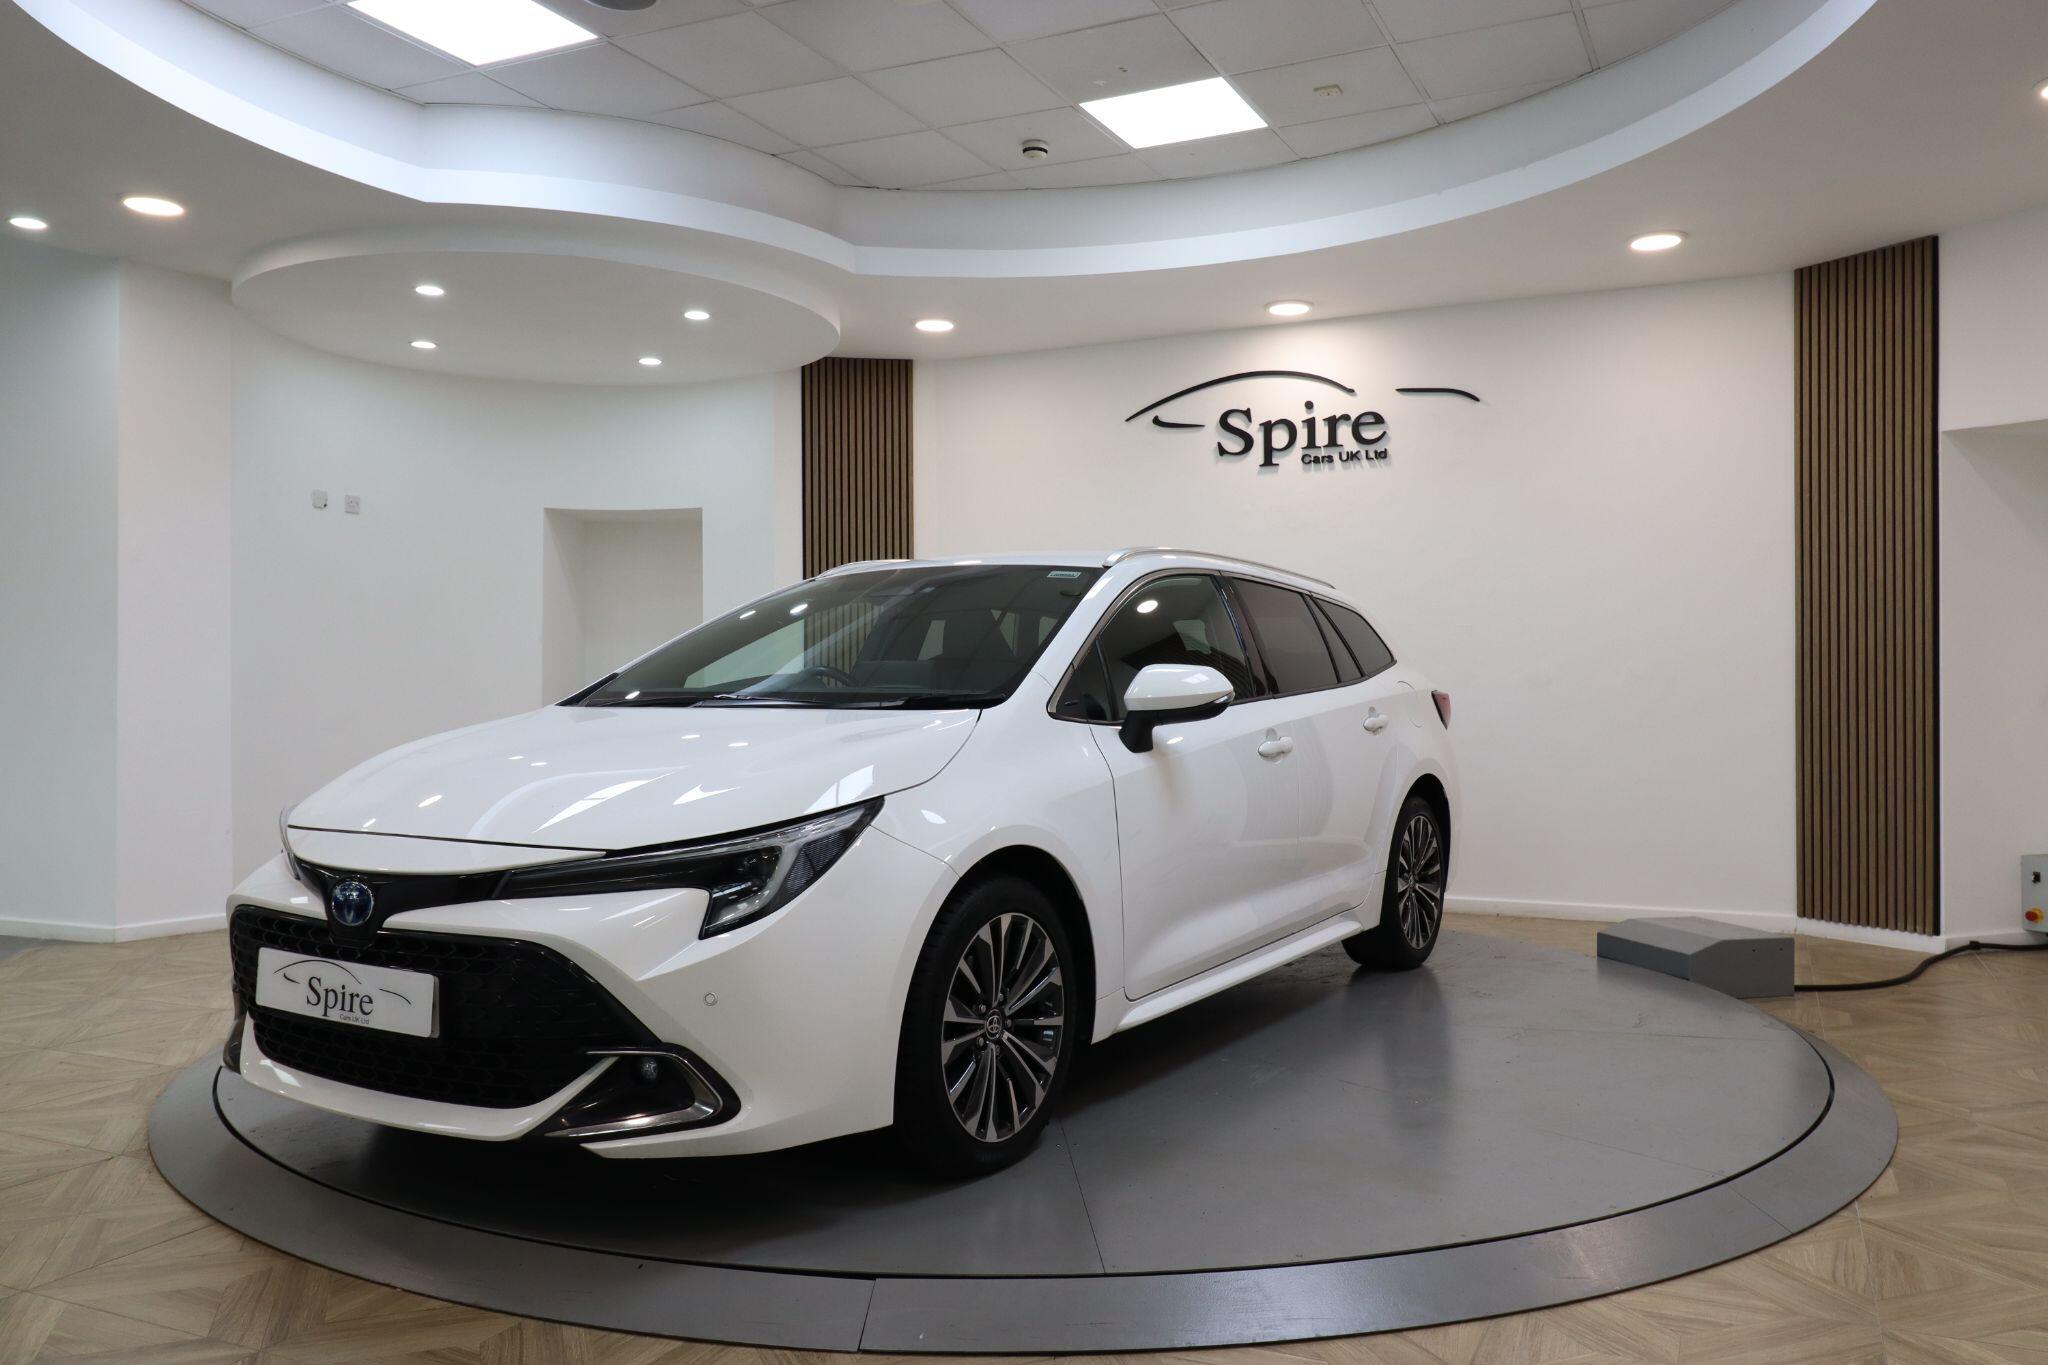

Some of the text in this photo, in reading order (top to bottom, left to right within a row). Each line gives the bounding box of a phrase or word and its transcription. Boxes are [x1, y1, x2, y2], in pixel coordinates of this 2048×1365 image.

[1217, 400, 1387, 467] Spire
[1301, 447, 1388, 465] Cars UK Ltd
[306, 976, 374, 1017] Spire
